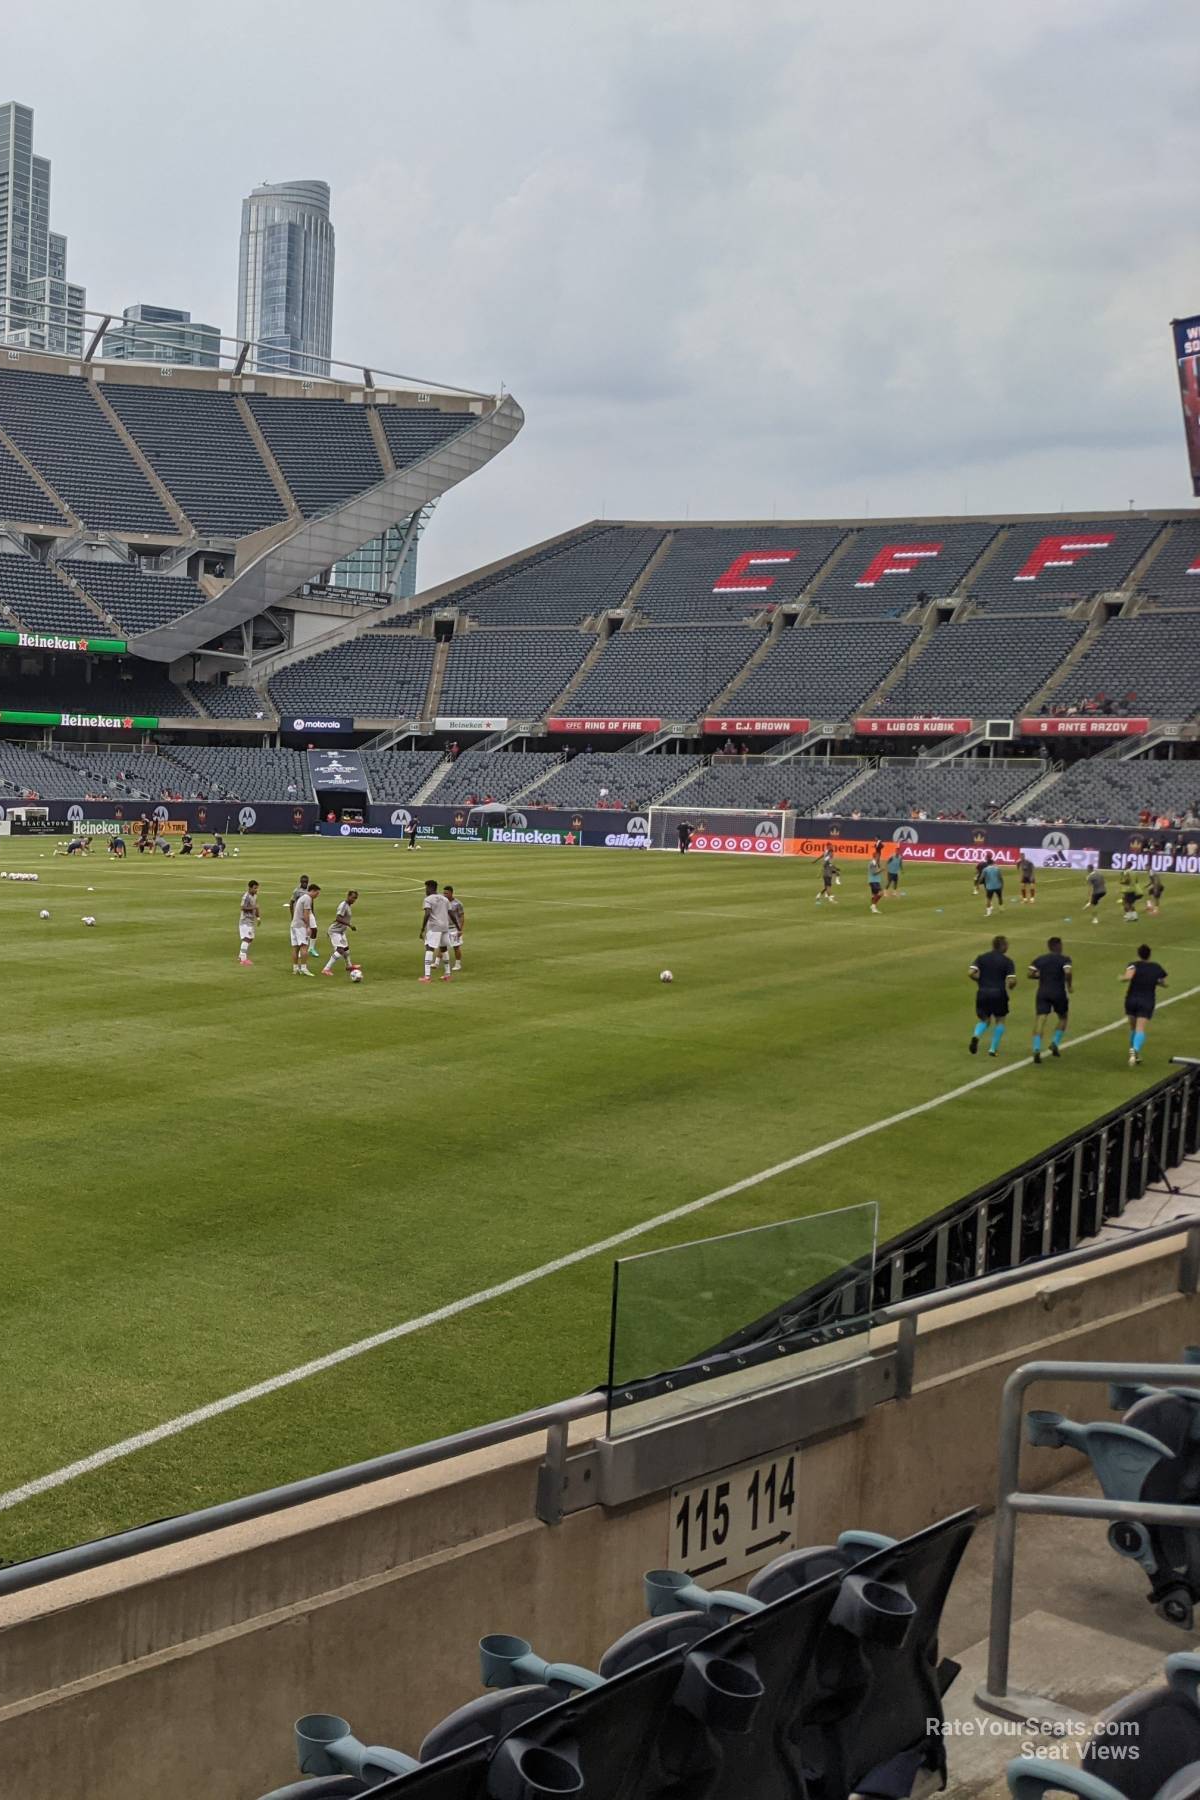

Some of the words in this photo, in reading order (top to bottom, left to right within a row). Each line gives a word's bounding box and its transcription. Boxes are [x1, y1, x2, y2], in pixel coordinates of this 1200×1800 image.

[18, 633, 78, 651] Heineken
[60, 713, 119, 729] Heineken
[304, 720, 341, 729] motorola
[449, 720, 484, 729] Heineken
[584, 721, 606, 730] RING
[607, 721, 620, 730] OF
[622, 721, 642, 730] FIRE
[720, 722, 728, 731] 2
[735, 722, 753, 731] C.J.
[754, 722, 791, 731] BROWN
[886, 722, 921, 731] LUBOS
[923, 722, 955, 731] KUBIK
[1040, 722, 1048, 731] 9
[1057, 722, 1087, 731] ANTE
[1090, 722, 1129, 731] RAZOV
[72, 820, 120, 835] Heineken
[350, 826, 383, 835] motorola
[457, 827, 478, 835] RUSH
[492, 828, 561, 844] Heineken
[903, 846, 936, 858] Audi
[1111, 852, 1150, 871] SIGN
[1151, 855, 1173, 873] UP
[676, 1481, 730, 1560] 115
[747, 1456, 795, 1531] 114
